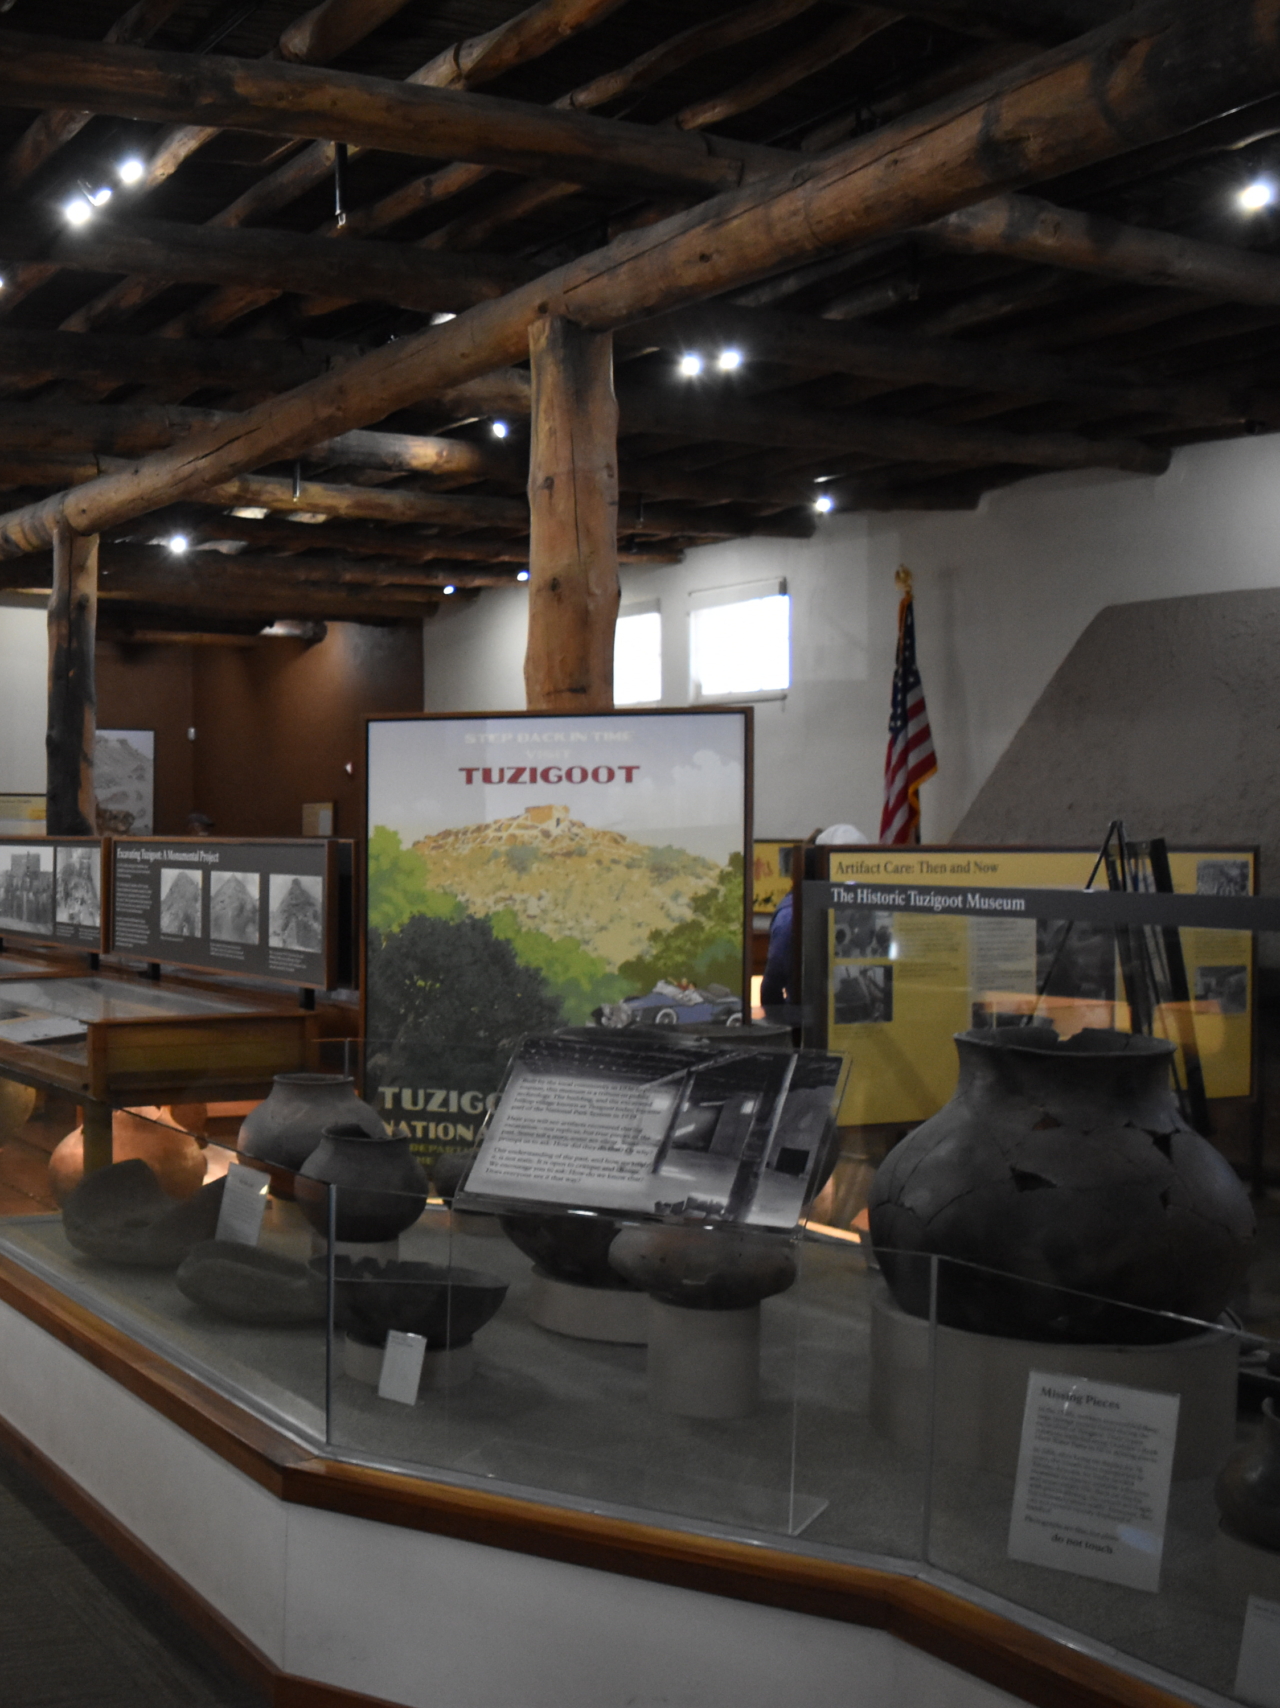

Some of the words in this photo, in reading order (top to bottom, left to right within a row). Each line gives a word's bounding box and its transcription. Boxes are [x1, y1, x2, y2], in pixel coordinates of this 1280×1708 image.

[458, 765, 640, 785] TUZIGOOT
[117, 848, 140, 863] Excavating
[163, 849, 167, 860] A
[167, 849, 199, 862] Monumental
[200, 850, 219, 865] Project
[836, 861, 881, 875] Artifact
[884, 861, 915, 874] Care:
[919, 860, 946, 874] Then
[950, 860, 970, 874] and
[973, 861, 1000, 873] Now
[831, 888, 854, 904] The
[857, 888, 906, 906] Historic
[908, 890, 963, 912] Tuzigoot
[966, 892, 1026, 911] Museum
[1041, 1386, 1083, 1406] Missing
[1085, 1395, 1120, 1410] Pieces
[1051, 1533, 1064, 1544] do
[1066, 1538, 1082, 1548] not
[1084, 1541, 1113, 1555] touch
